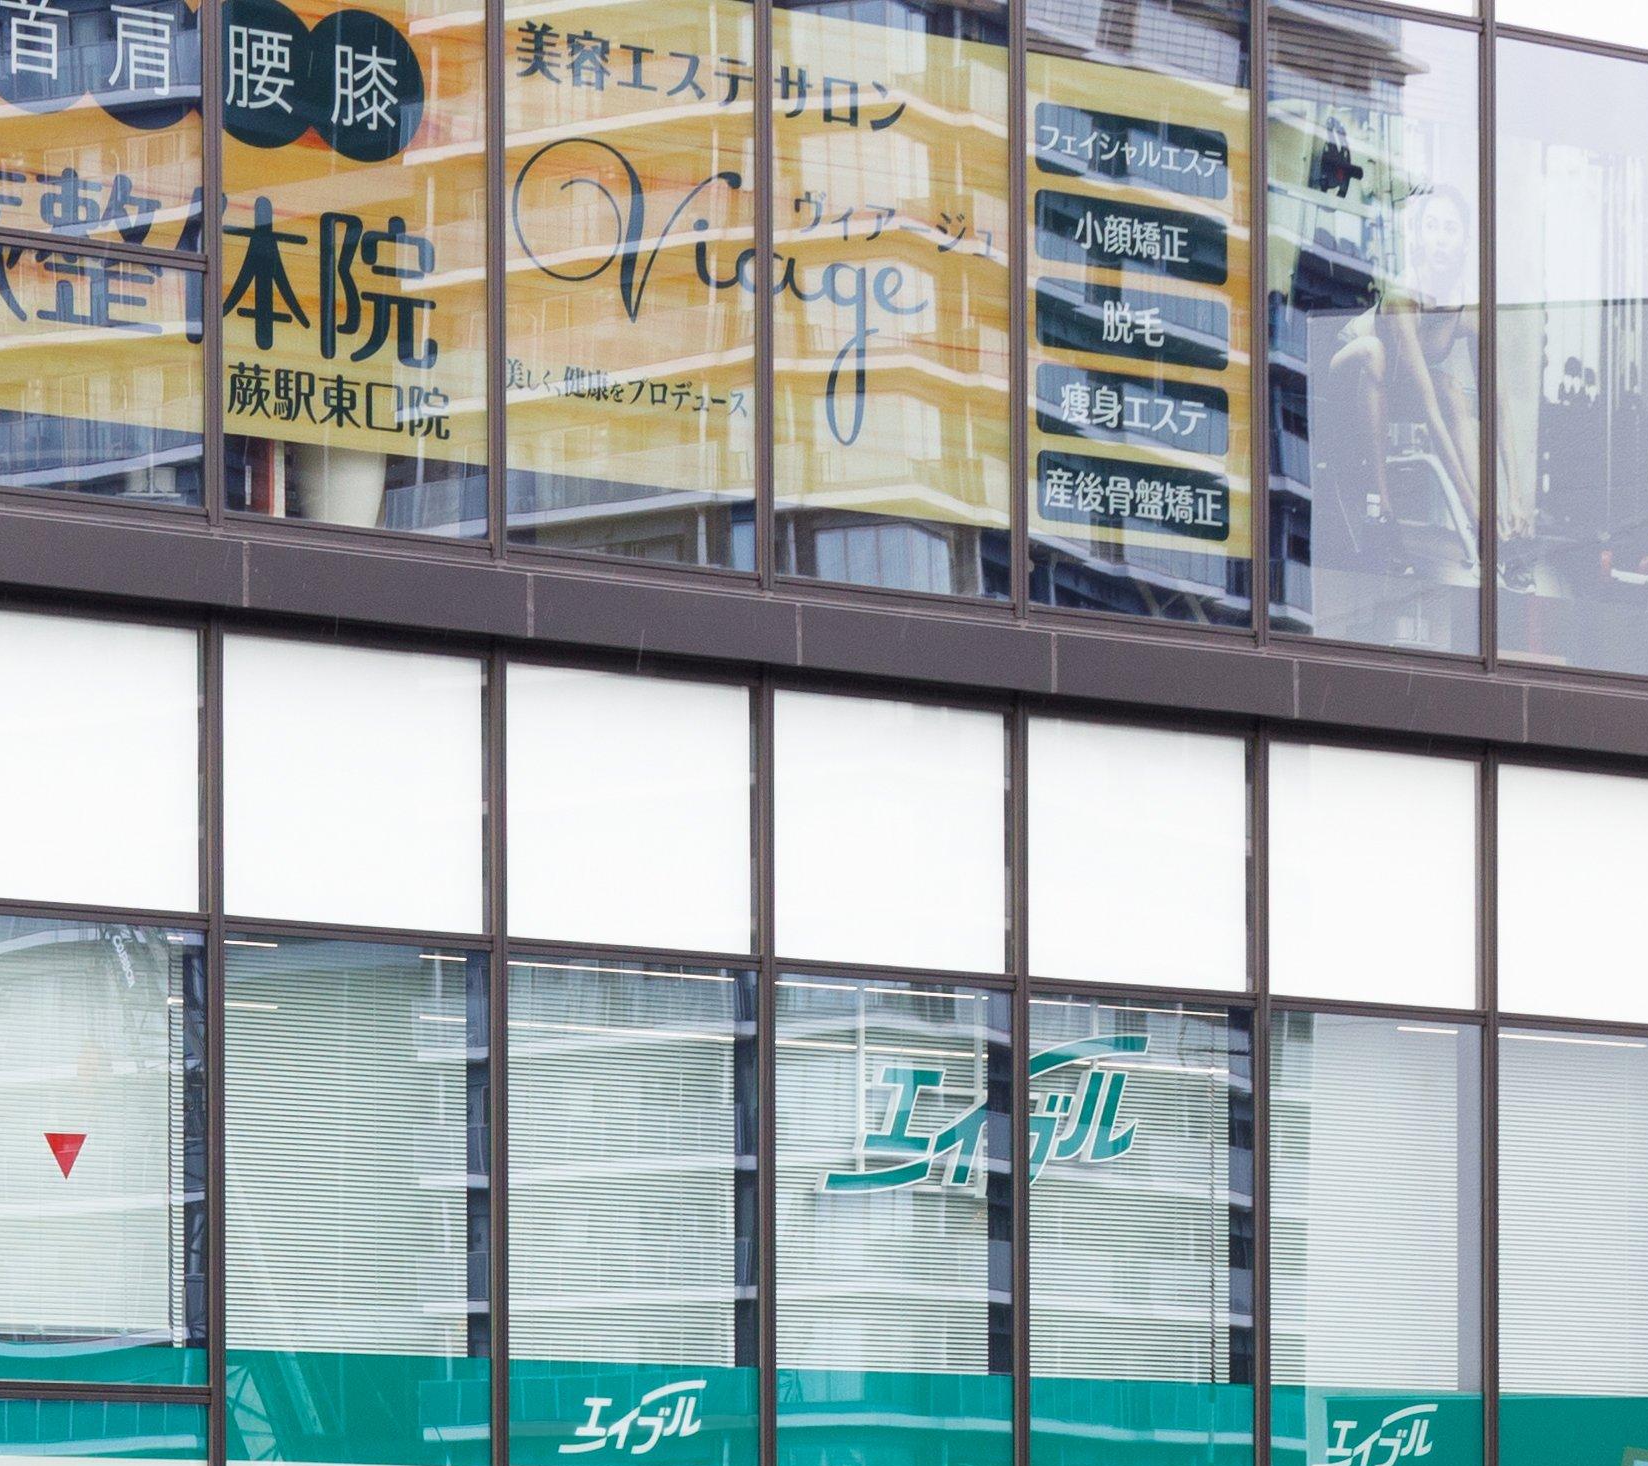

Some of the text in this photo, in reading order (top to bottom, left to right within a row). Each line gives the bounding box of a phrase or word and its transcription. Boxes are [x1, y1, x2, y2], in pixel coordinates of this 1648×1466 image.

[109, 5, 172, 97] 肩
[226, 23, 295, 115] 腰
[331, 44, 399, 131] 膝
[515, 20, 907, 131] 美容エステサロン
[1037, 122, 1227, 180] フェイシャルエステ
[794, 190, 994, 260] ヴィアージュ
[1074, 209, 1190, 263] 小顔矯正
[1101, 300, 1165, 348] 脱毛
[227, 361, 451, 440] 蕨駅東口院
[1059, 381, 1208, 436] 痩身エステ
[1043, 468, 1224, 528] 産後骨盤矯正
[557, 1379, 707, 1456] エイブル
